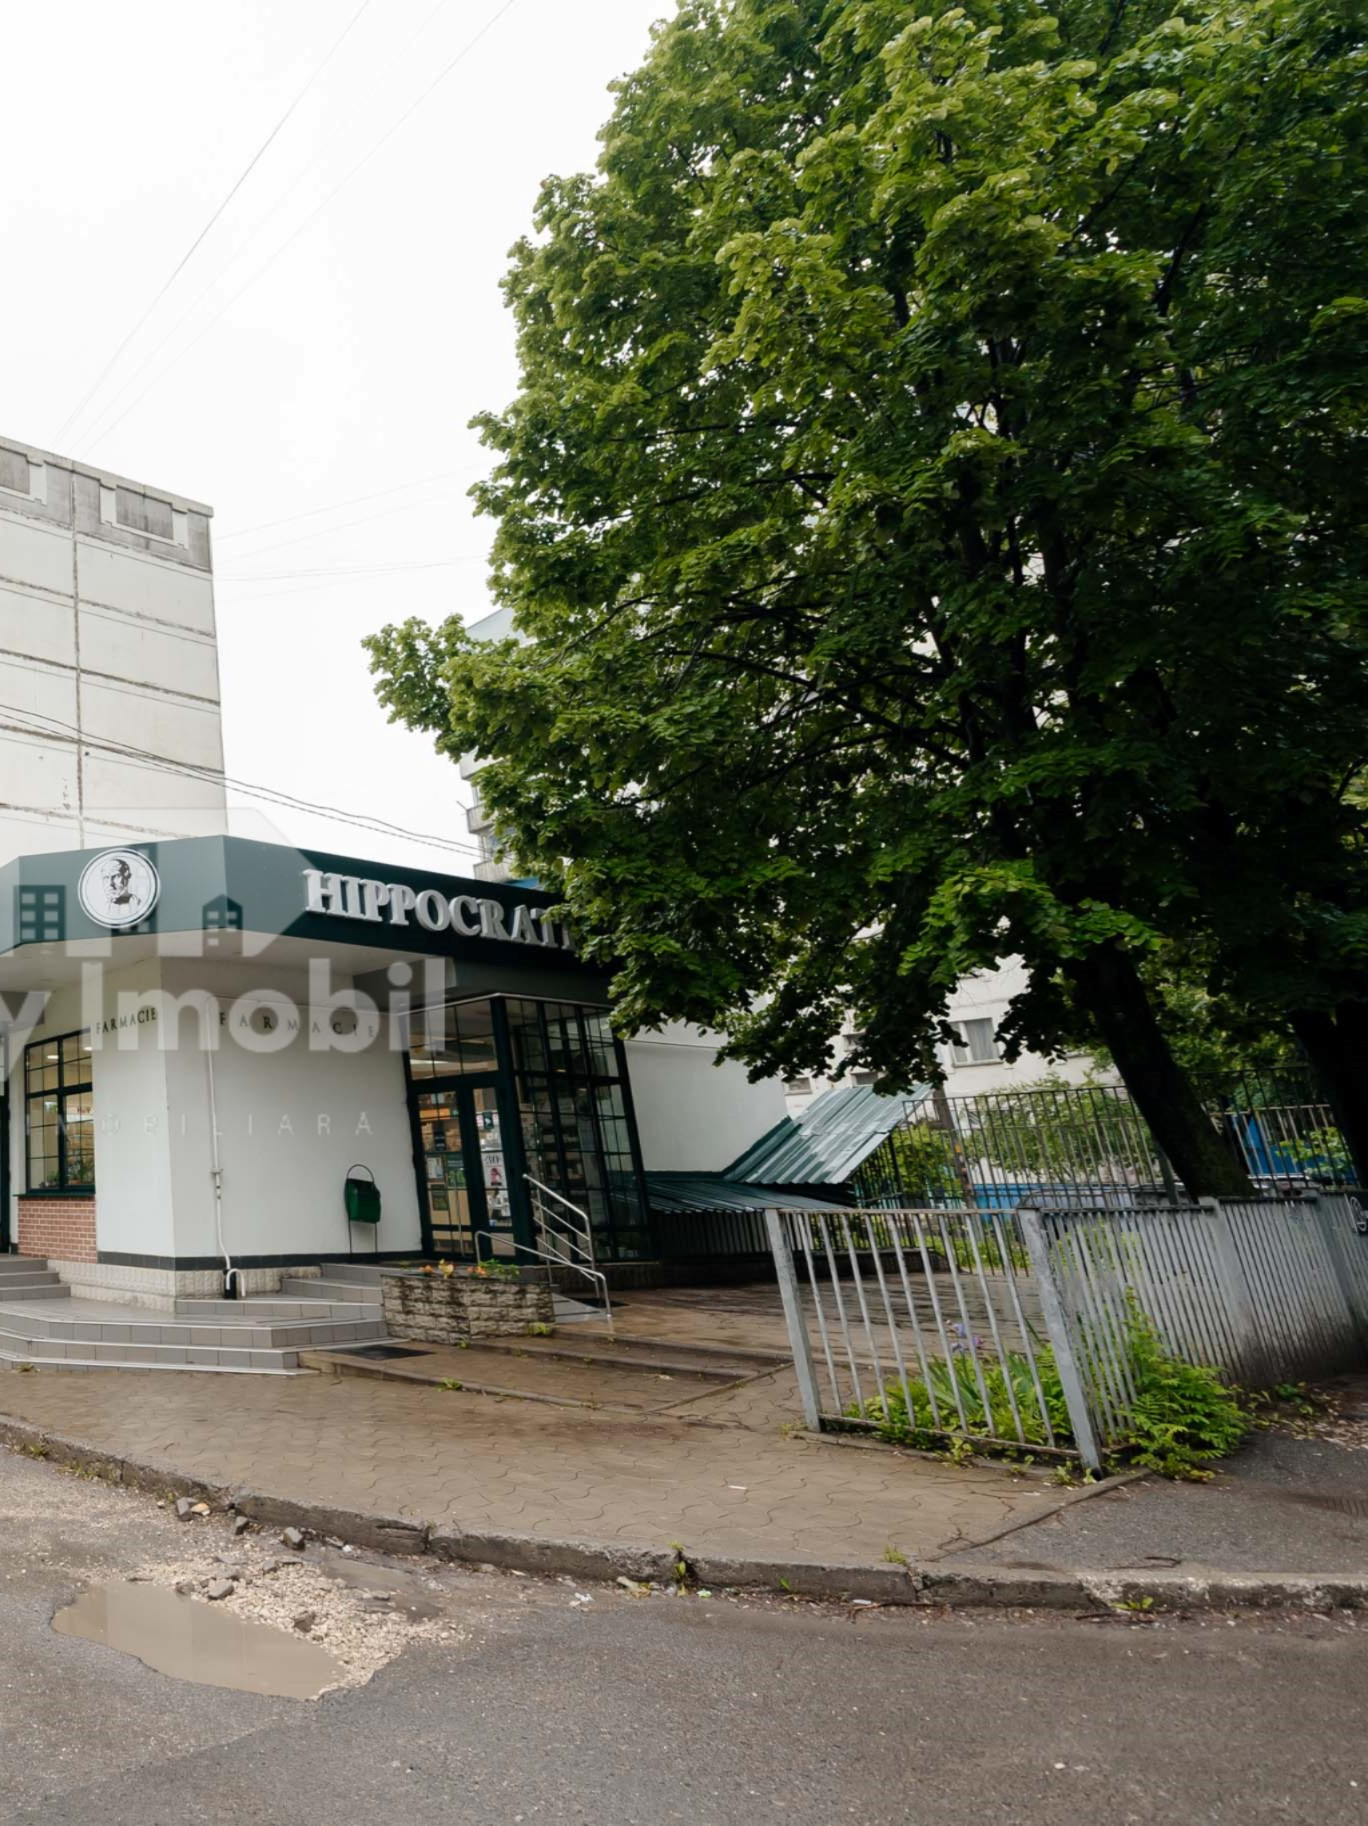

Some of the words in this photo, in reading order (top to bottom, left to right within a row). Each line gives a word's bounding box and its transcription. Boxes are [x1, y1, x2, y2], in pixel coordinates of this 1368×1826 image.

[302, 868, 575, 950] HIPPOCRAT
[95, 1008, 157, 1036] FARMACIE
[219, 1011, 375, 1038] FARMACIE
